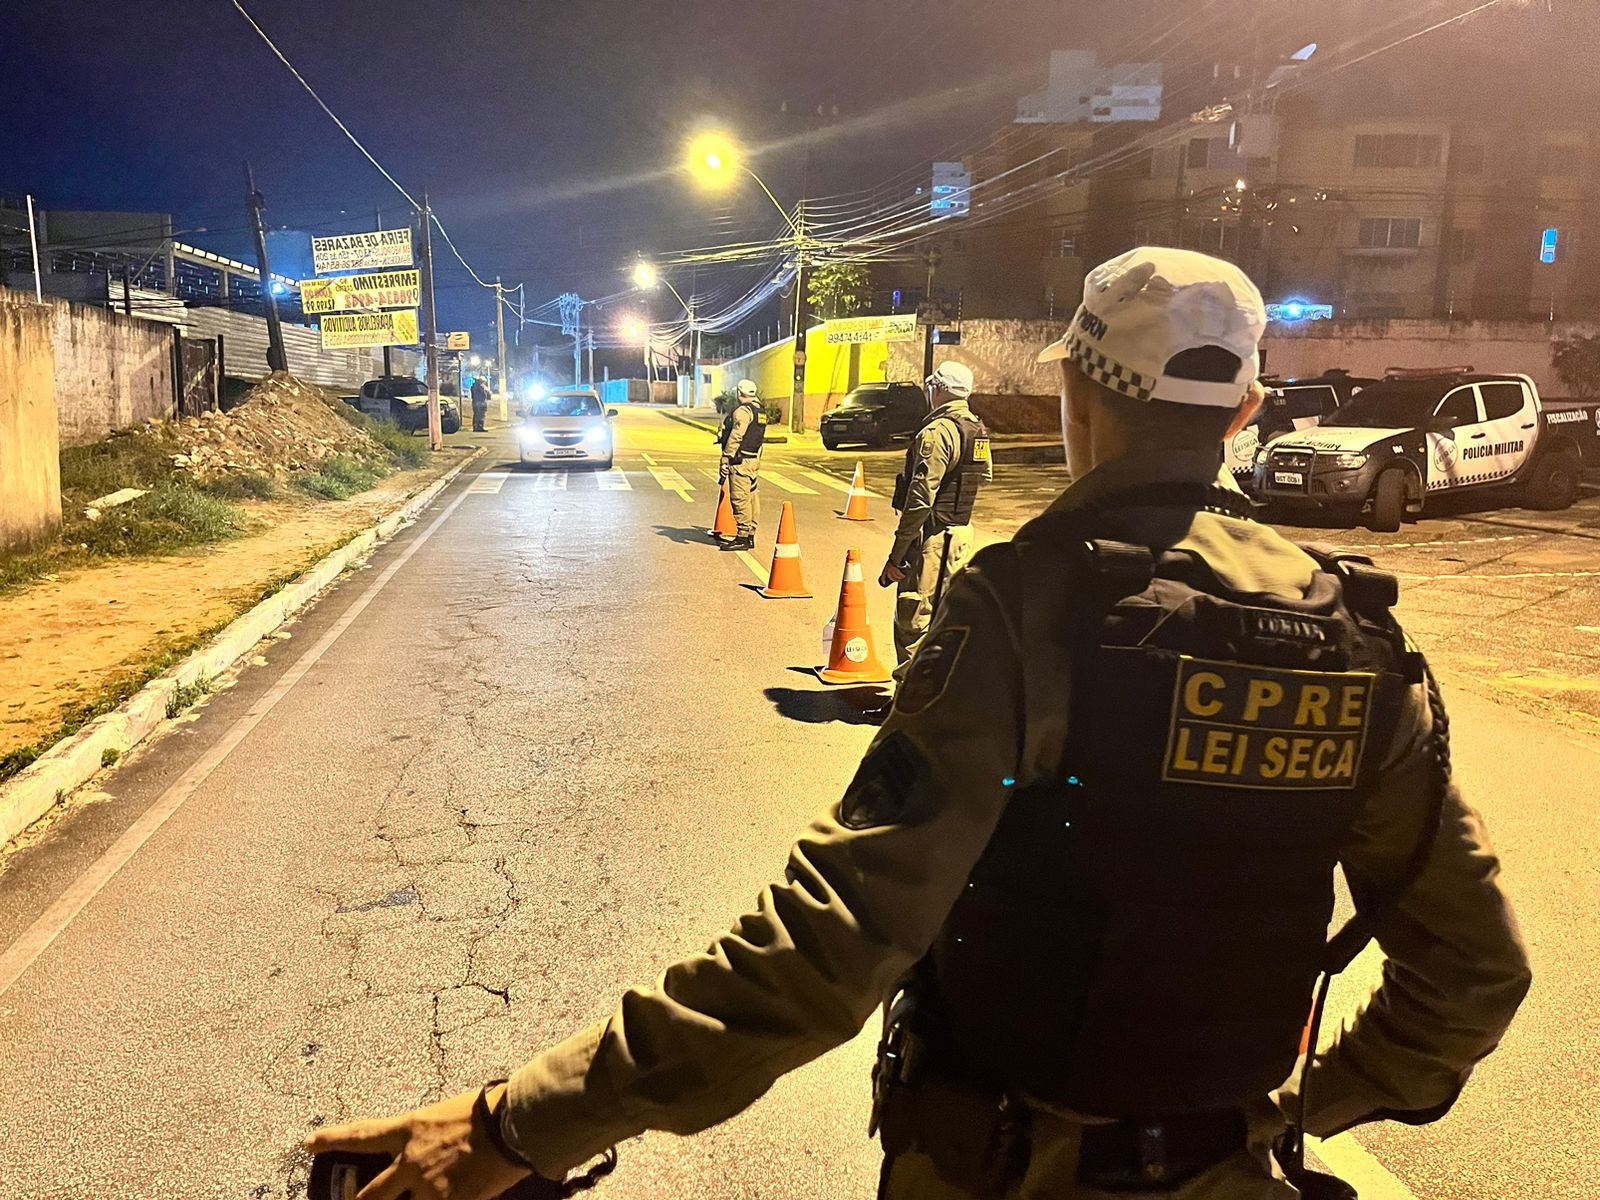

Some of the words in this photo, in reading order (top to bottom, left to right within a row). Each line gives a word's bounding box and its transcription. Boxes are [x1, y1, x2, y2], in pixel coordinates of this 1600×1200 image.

[1546, 409, 1589, 425] FISCALIZAÇÃO
[1463, 443, 1493, 461] POLÍCIA
[1494, 440, 1524, 456] MILITAR
[1172, 727, 1249, 776] LEI
[1259, 736, 1355, 780] SECA
